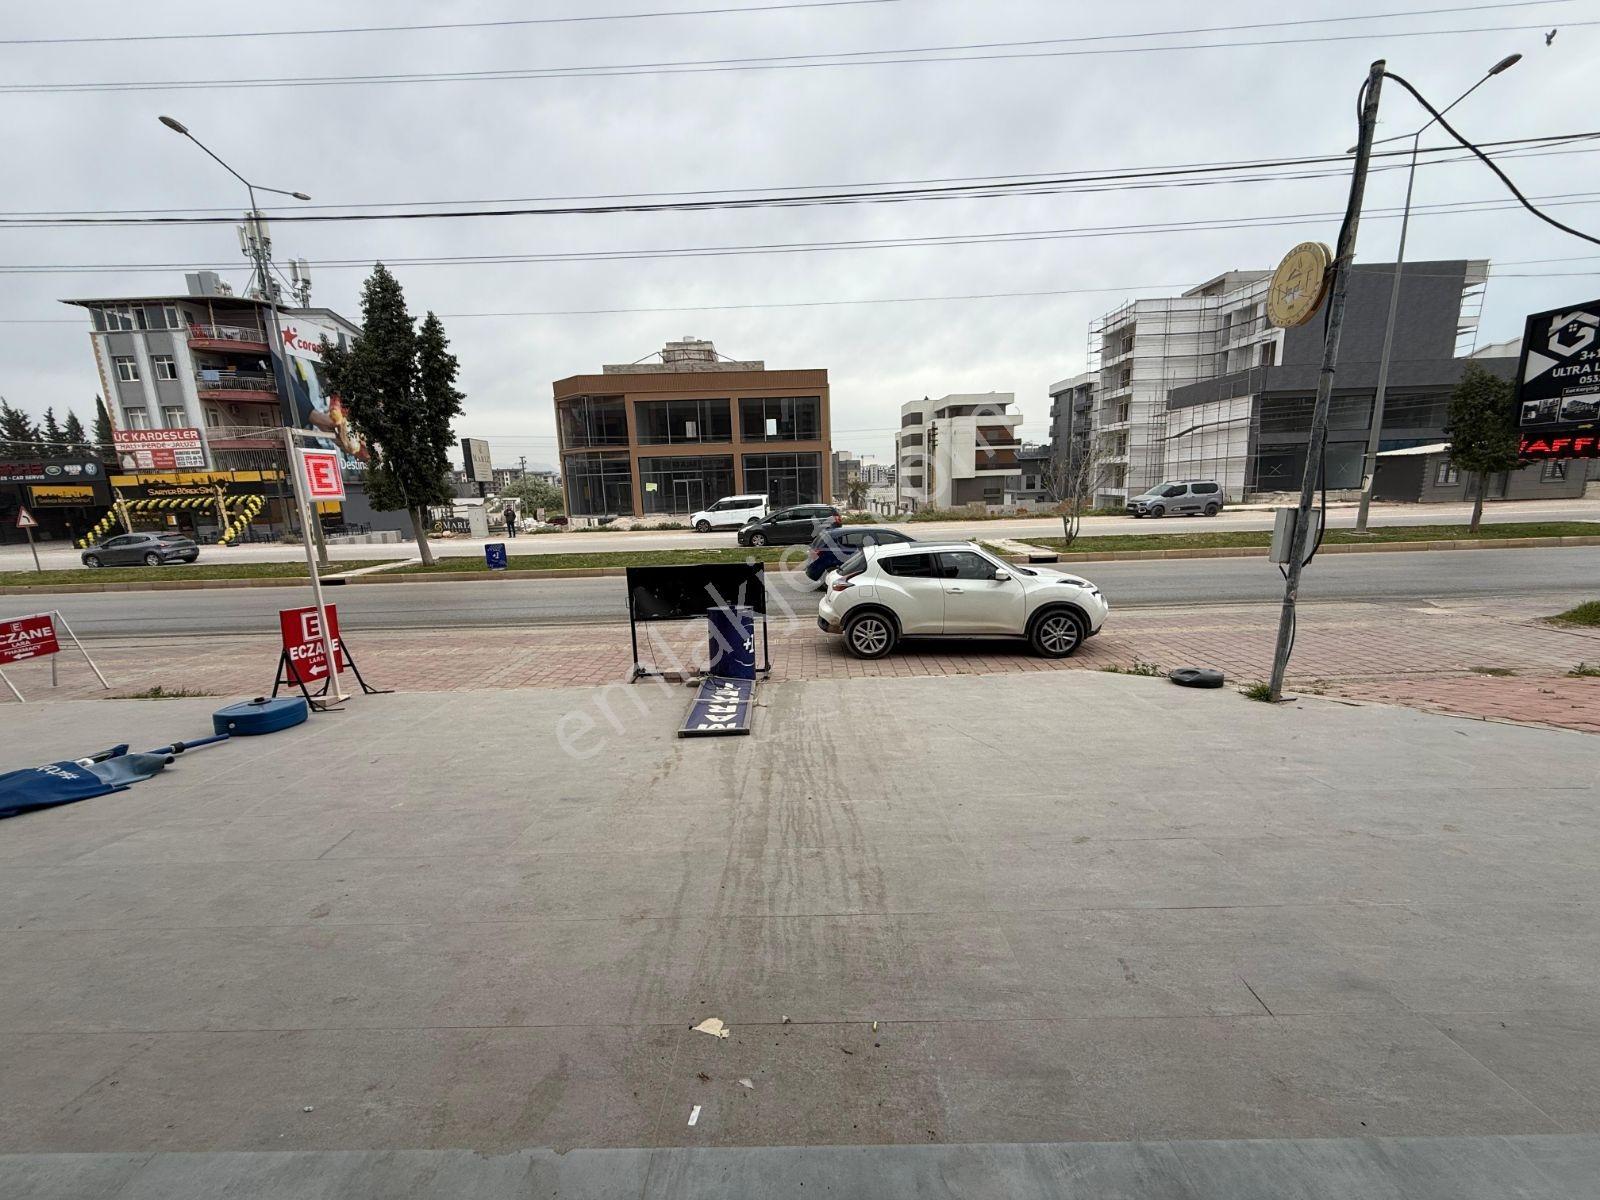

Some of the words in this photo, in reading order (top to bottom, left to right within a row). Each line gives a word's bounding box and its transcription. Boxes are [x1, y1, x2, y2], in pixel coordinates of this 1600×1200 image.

[1552, 364, 1591, 377] ULTRA
[313, 463, 333, 488] E
[11, 640, 31, 648] LARA
[290, 638, 340, 661] ECZAE
[4, 645, 41, 656] PHARMACY
[309, 656, 325, 664] LARA
